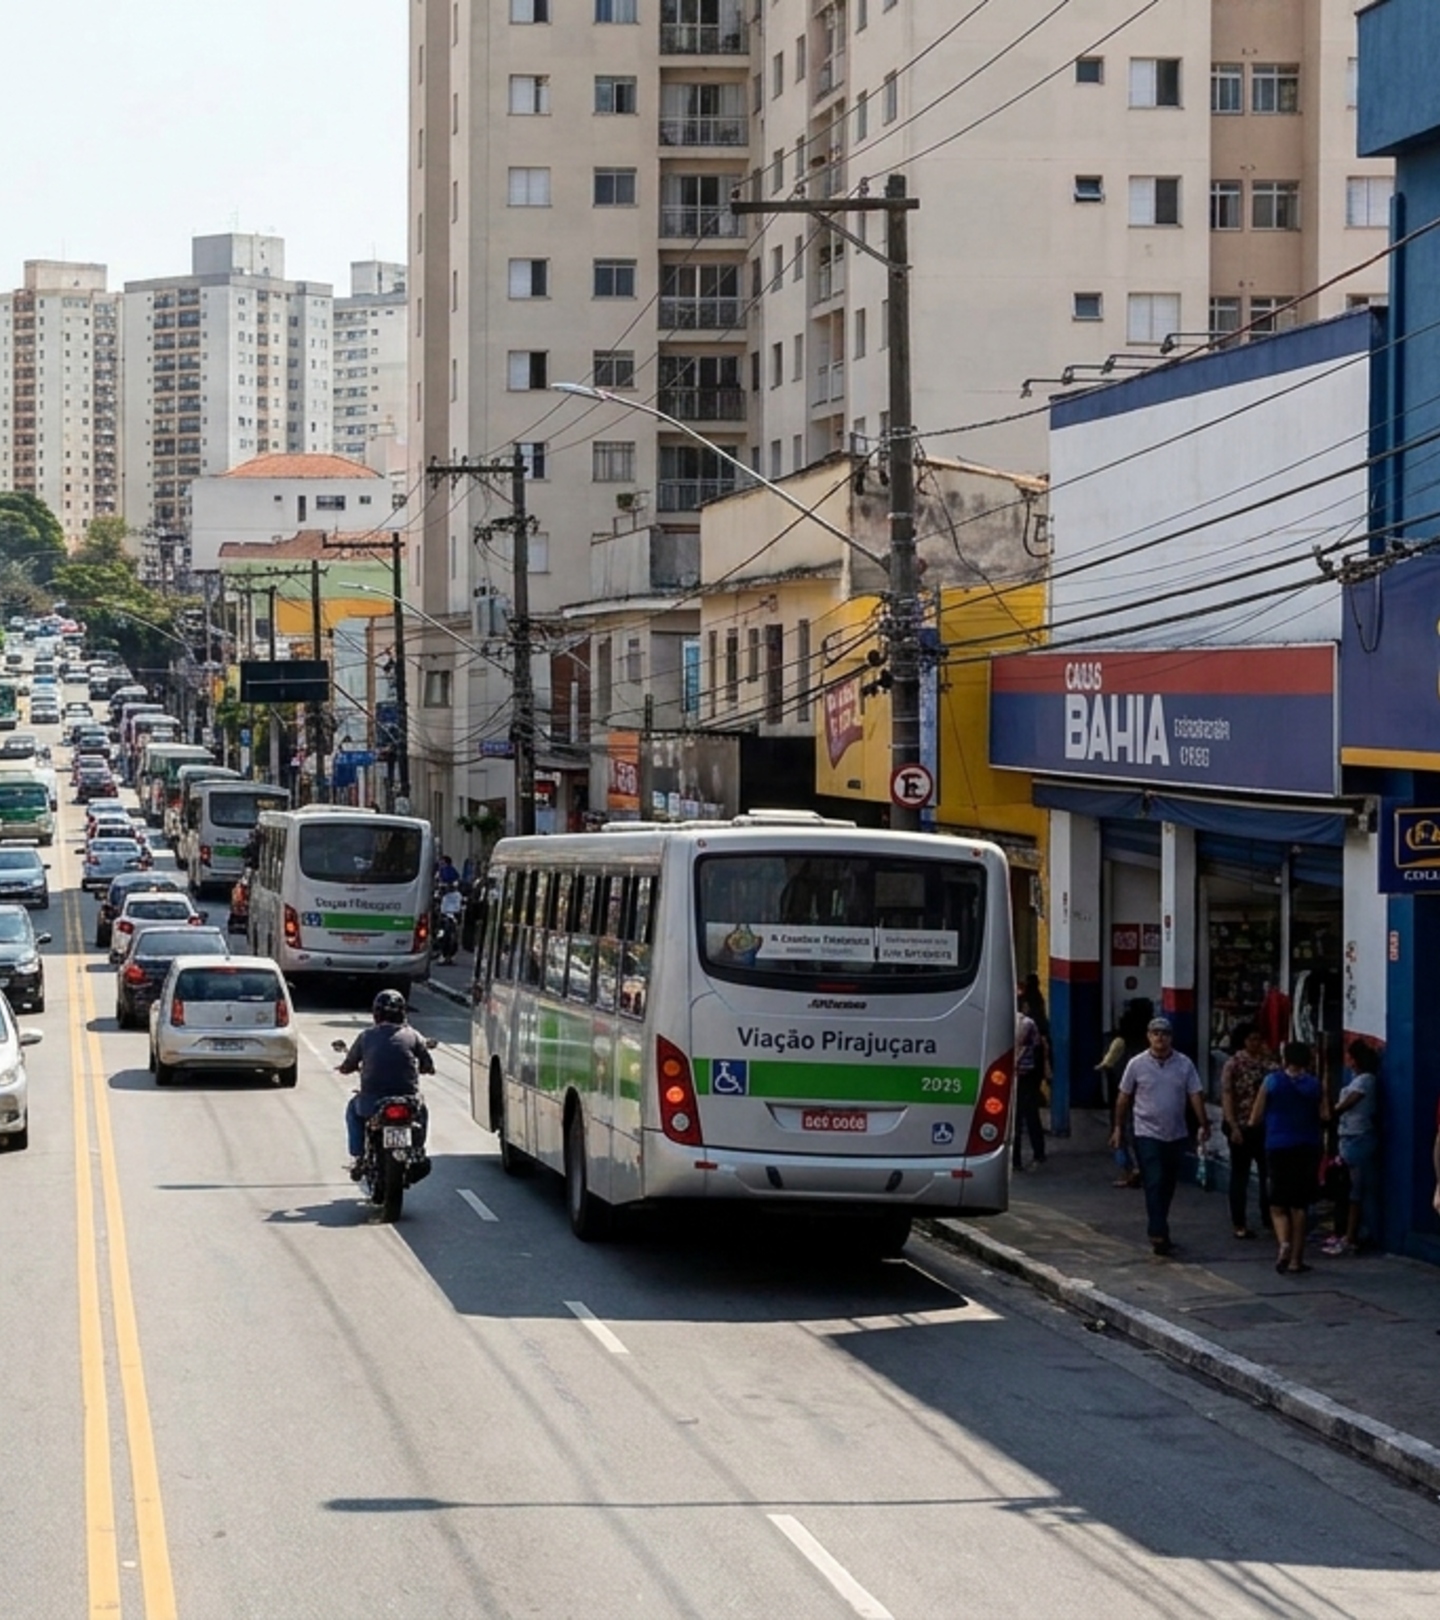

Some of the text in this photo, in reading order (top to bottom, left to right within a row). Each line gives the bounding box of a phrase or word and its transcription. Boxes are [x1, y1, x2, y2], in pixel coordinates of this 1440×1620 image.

[1065, 693, 1171, 767] BAHIA
[737, 1026, 937, 1059] Viação Pirajuçara
